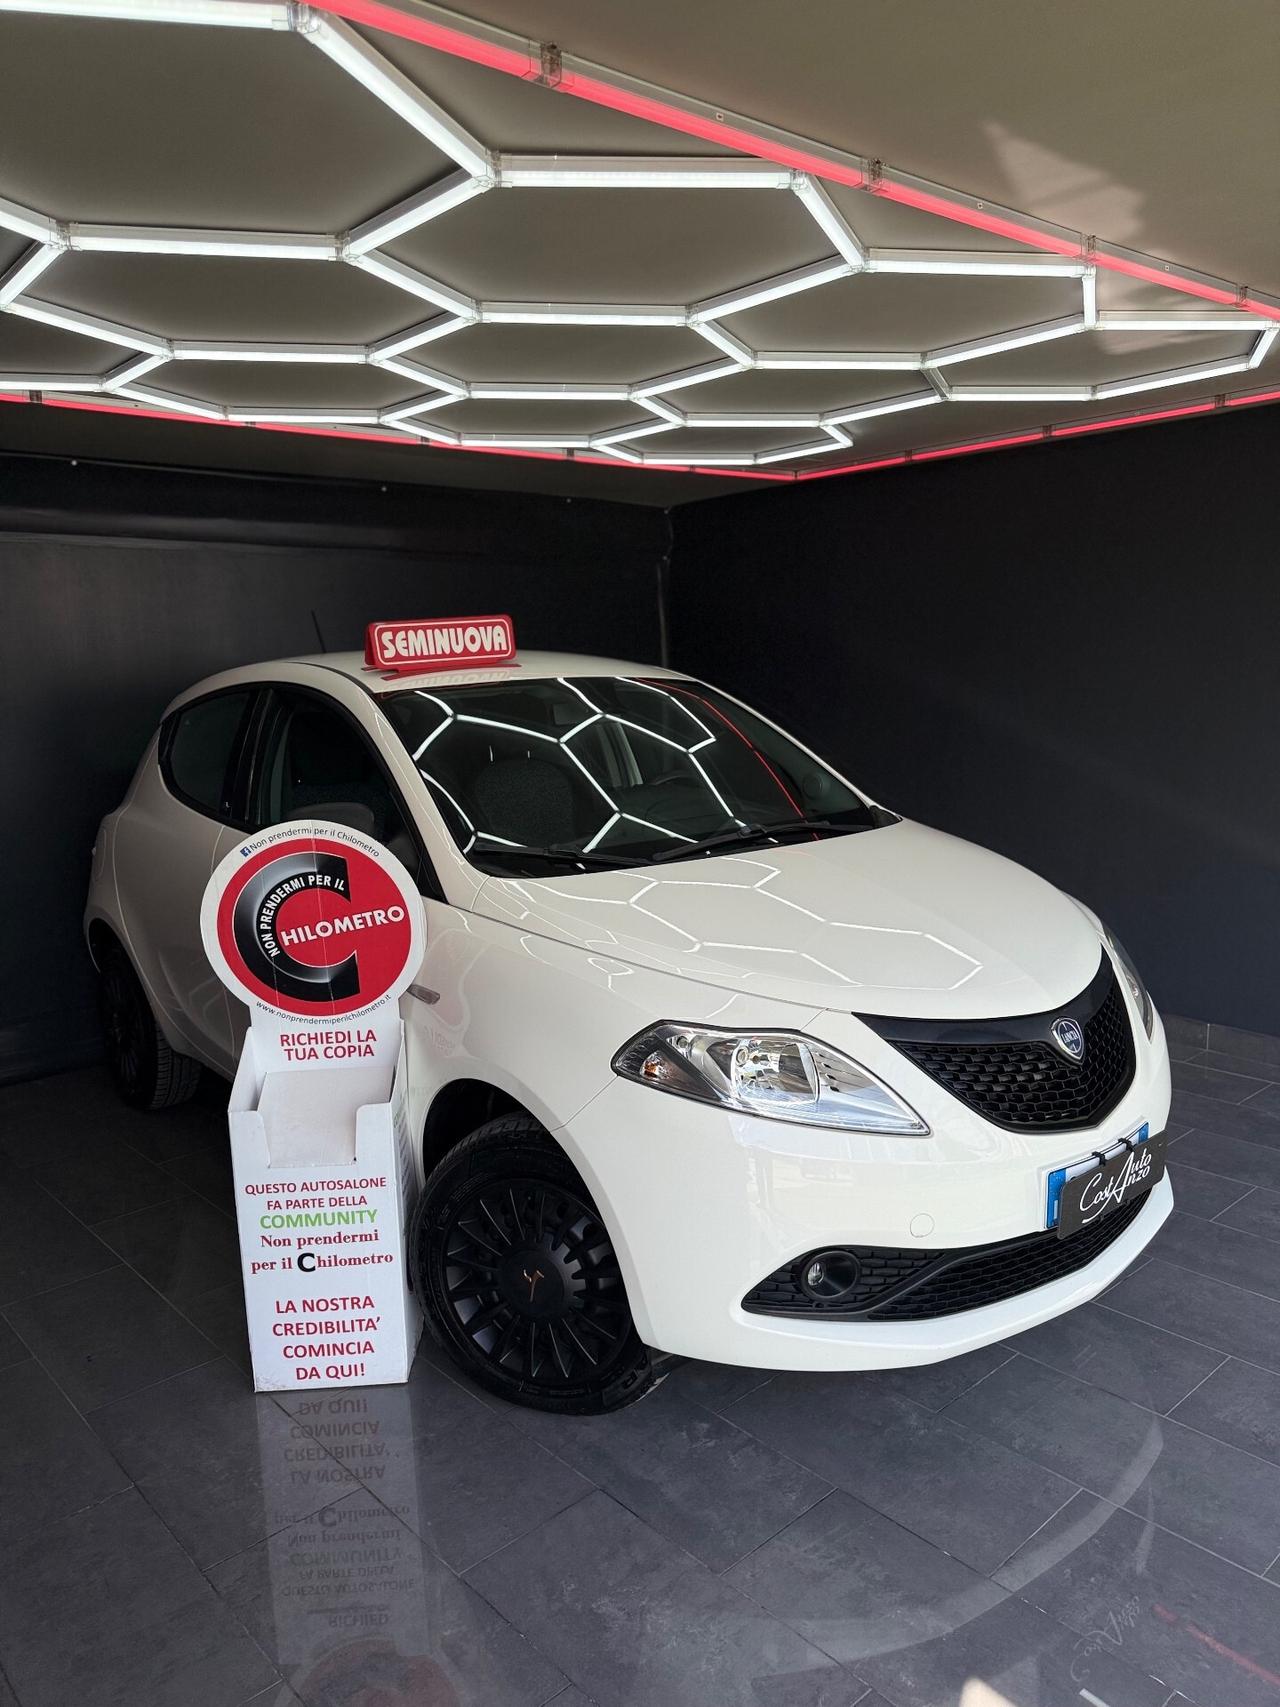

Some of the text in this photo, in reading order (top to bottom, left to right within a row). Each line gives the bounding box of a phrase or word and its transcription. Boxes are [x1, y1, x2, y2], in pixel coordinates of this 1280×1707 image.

[381, 625, 507, 659] SEMINUOVA
[250, 839, 267, 851] Non
[268, 826, 312, 842] prendermi
[314, 827, 328, 837] per
[330, 828, 336, 836] il
[337, 831, 380, 857] Chilometro
[260, 875, 345, 957] NON PRENDERMI PER IL
[280, 1029, 377, 1047] RICHIEDI LA
[284, 1043, 375, 1061] TUA COPIA
[245, 1176, 387, 1195] QUESTO AUTOSALONE
[267, 1195, 367, 1211] FA PARTE DELLA
[259, 1209, 378, 1230] COMMUNITY
[260, 1229, 379, 1250] Non prendermi
[250, 1252, 394, 1274] per il Chilometro
[275, 1295, 375, 1314] LA NOSTRA
[282, 1341, 375, 1359] COMINCIA
[295, 1363, 366, 1381] DA QUI!
